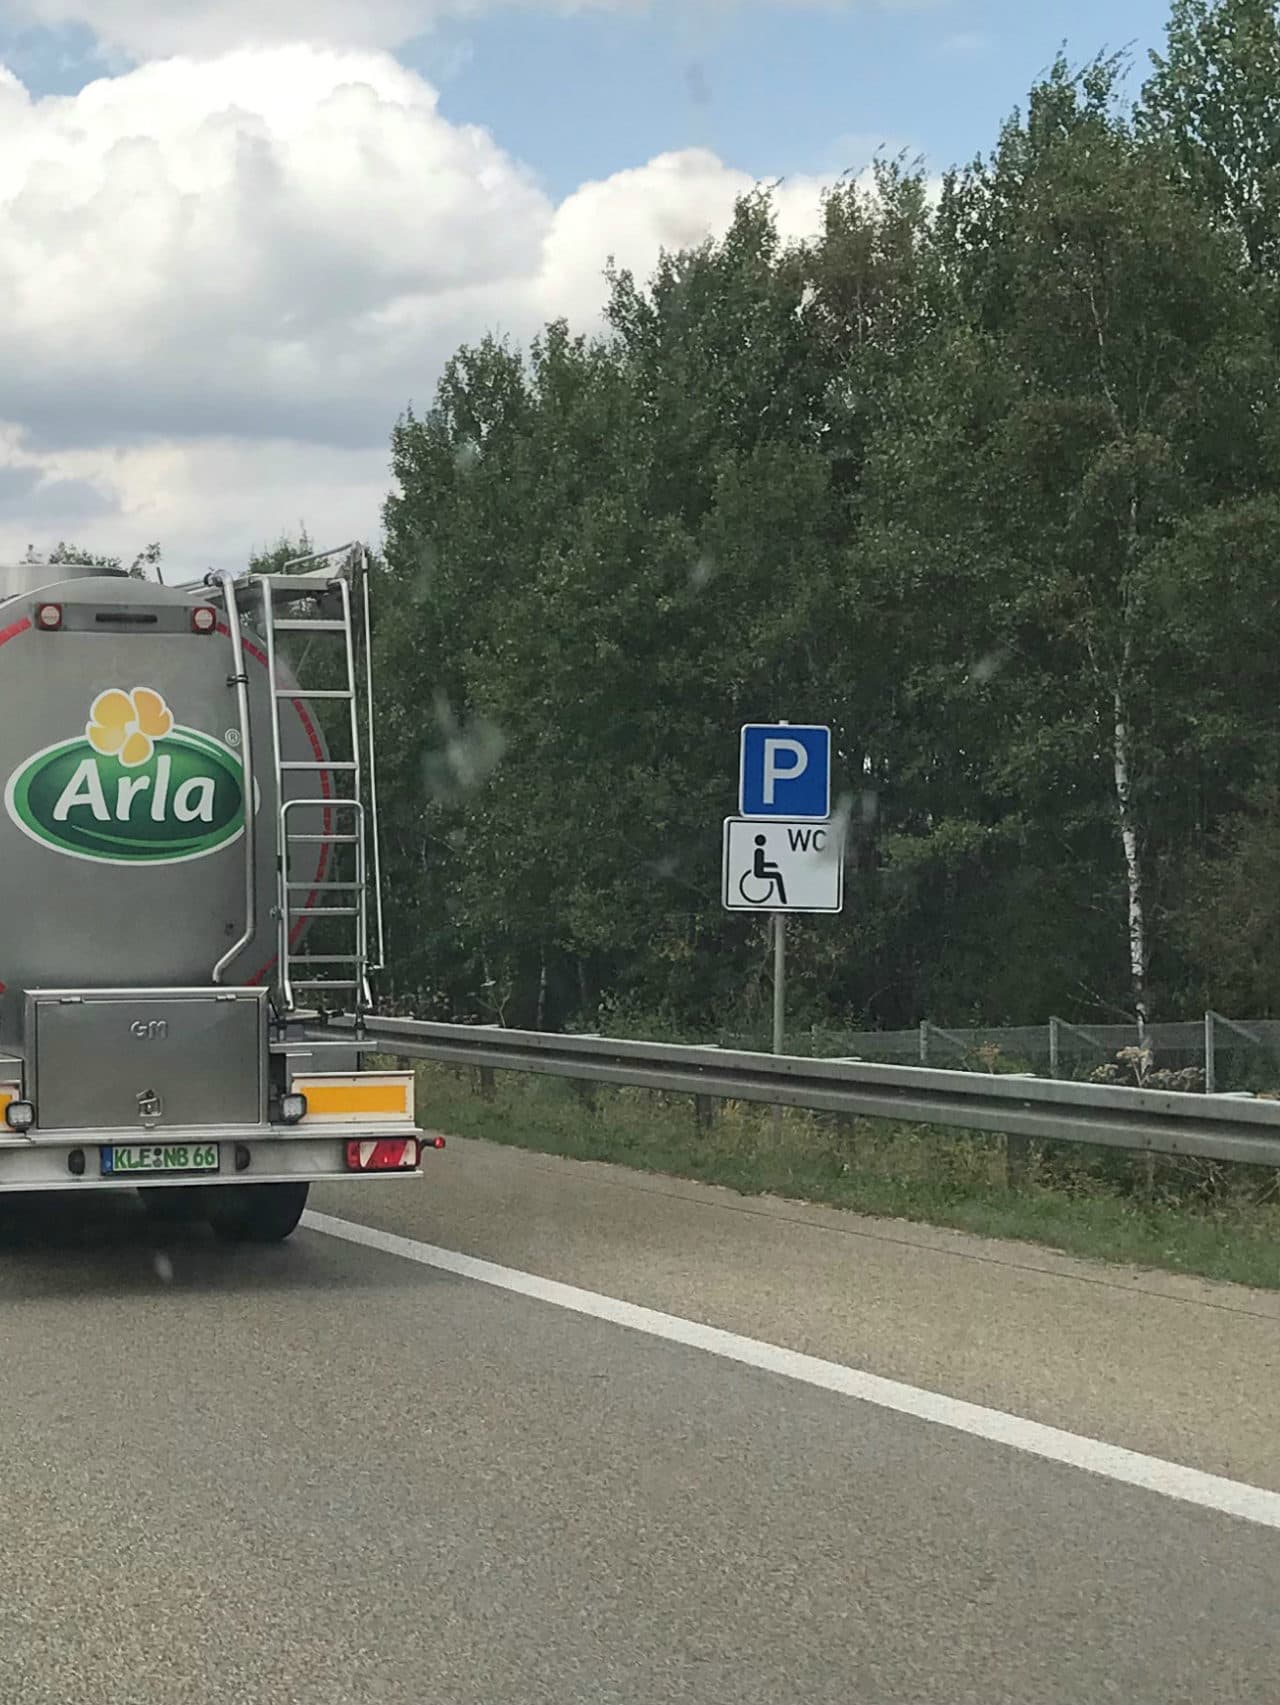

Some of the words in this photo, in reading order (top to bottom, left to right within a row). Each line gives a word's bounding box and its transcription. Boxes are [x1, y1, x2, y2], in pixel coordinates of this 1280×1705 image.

[52, 755, 216, 823] Arla
[763, 738, 809, 805] P
[787, 828, 828, 852] WC
[192, 1146, 216, 1167] 66
